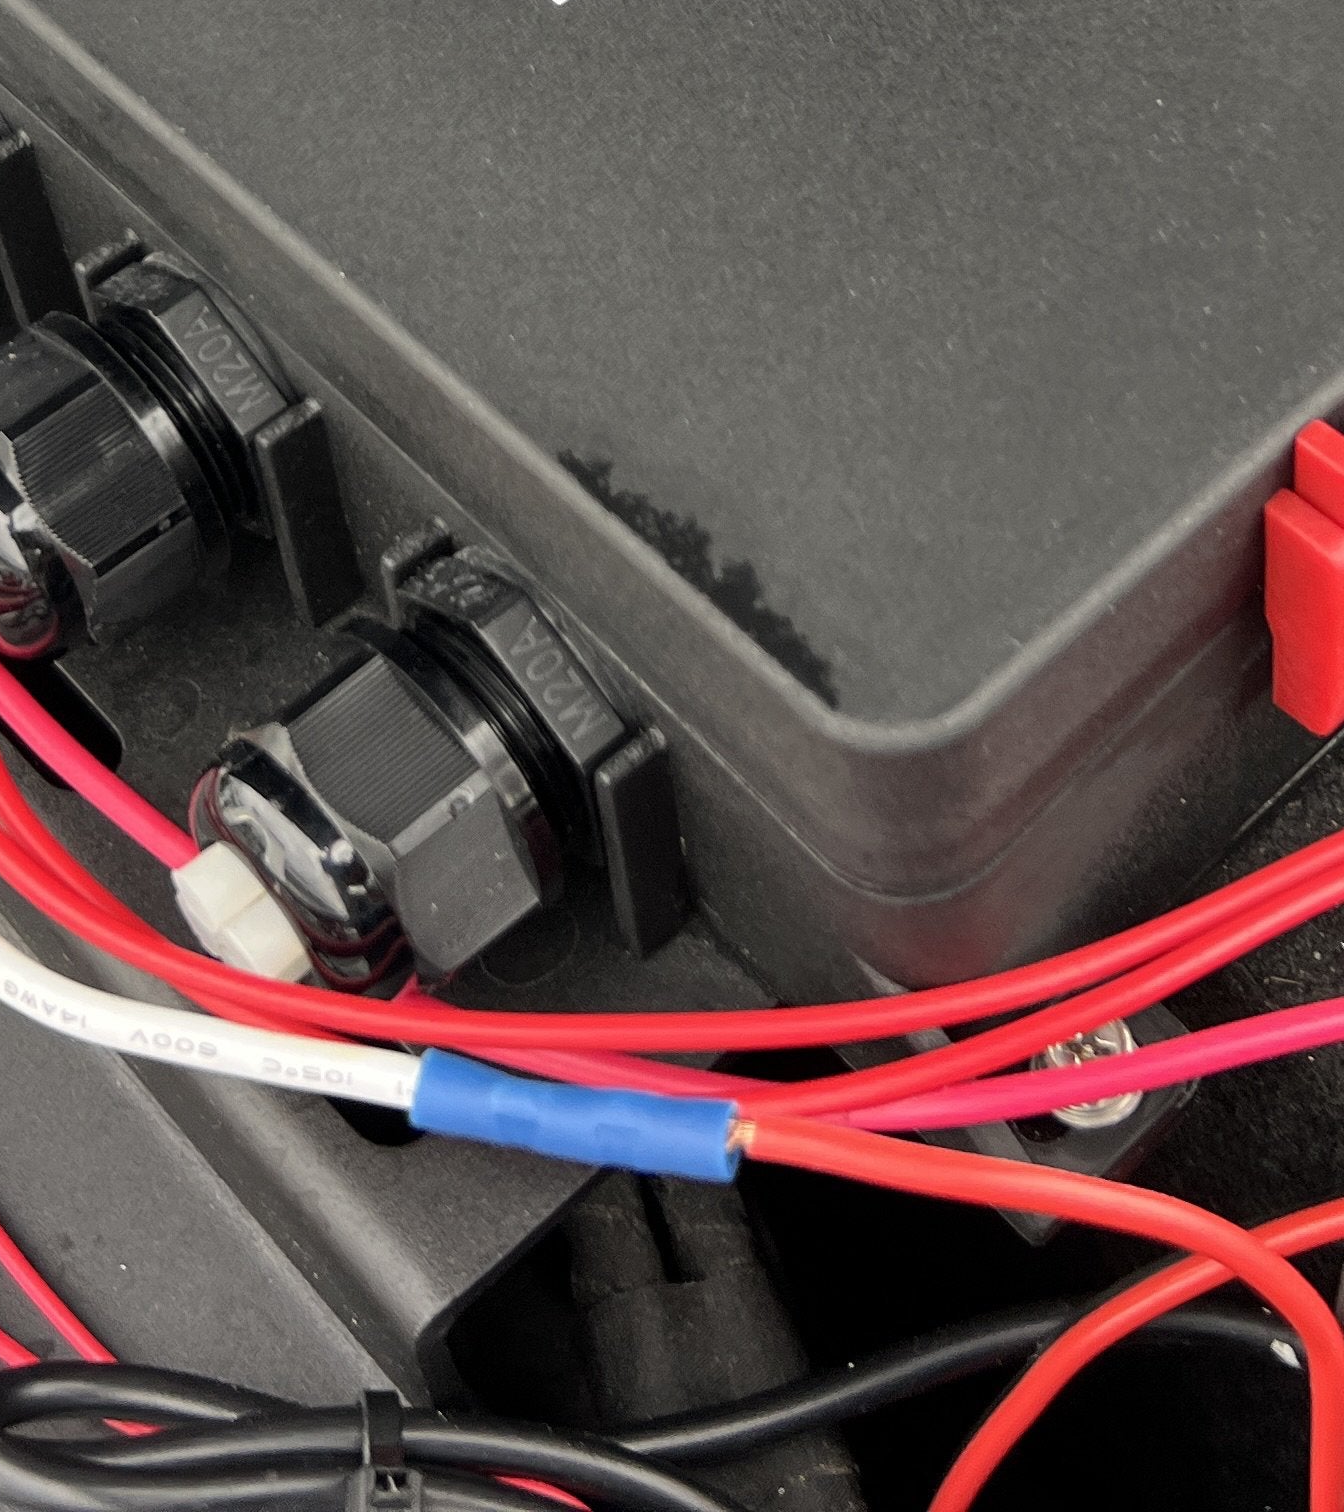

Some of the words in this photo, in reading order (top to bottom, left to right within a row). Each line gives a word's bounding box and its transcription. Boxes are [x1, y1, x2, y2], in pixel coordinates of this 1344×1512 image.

[183, 305, 267, 415] M20A
[503, 612, 599, 746] M20A
[2, 979, 89, 1030] 14AWG
[127, 1027, 218, 1060] 600V
[259, 1056, 355, 1086] 105°C
